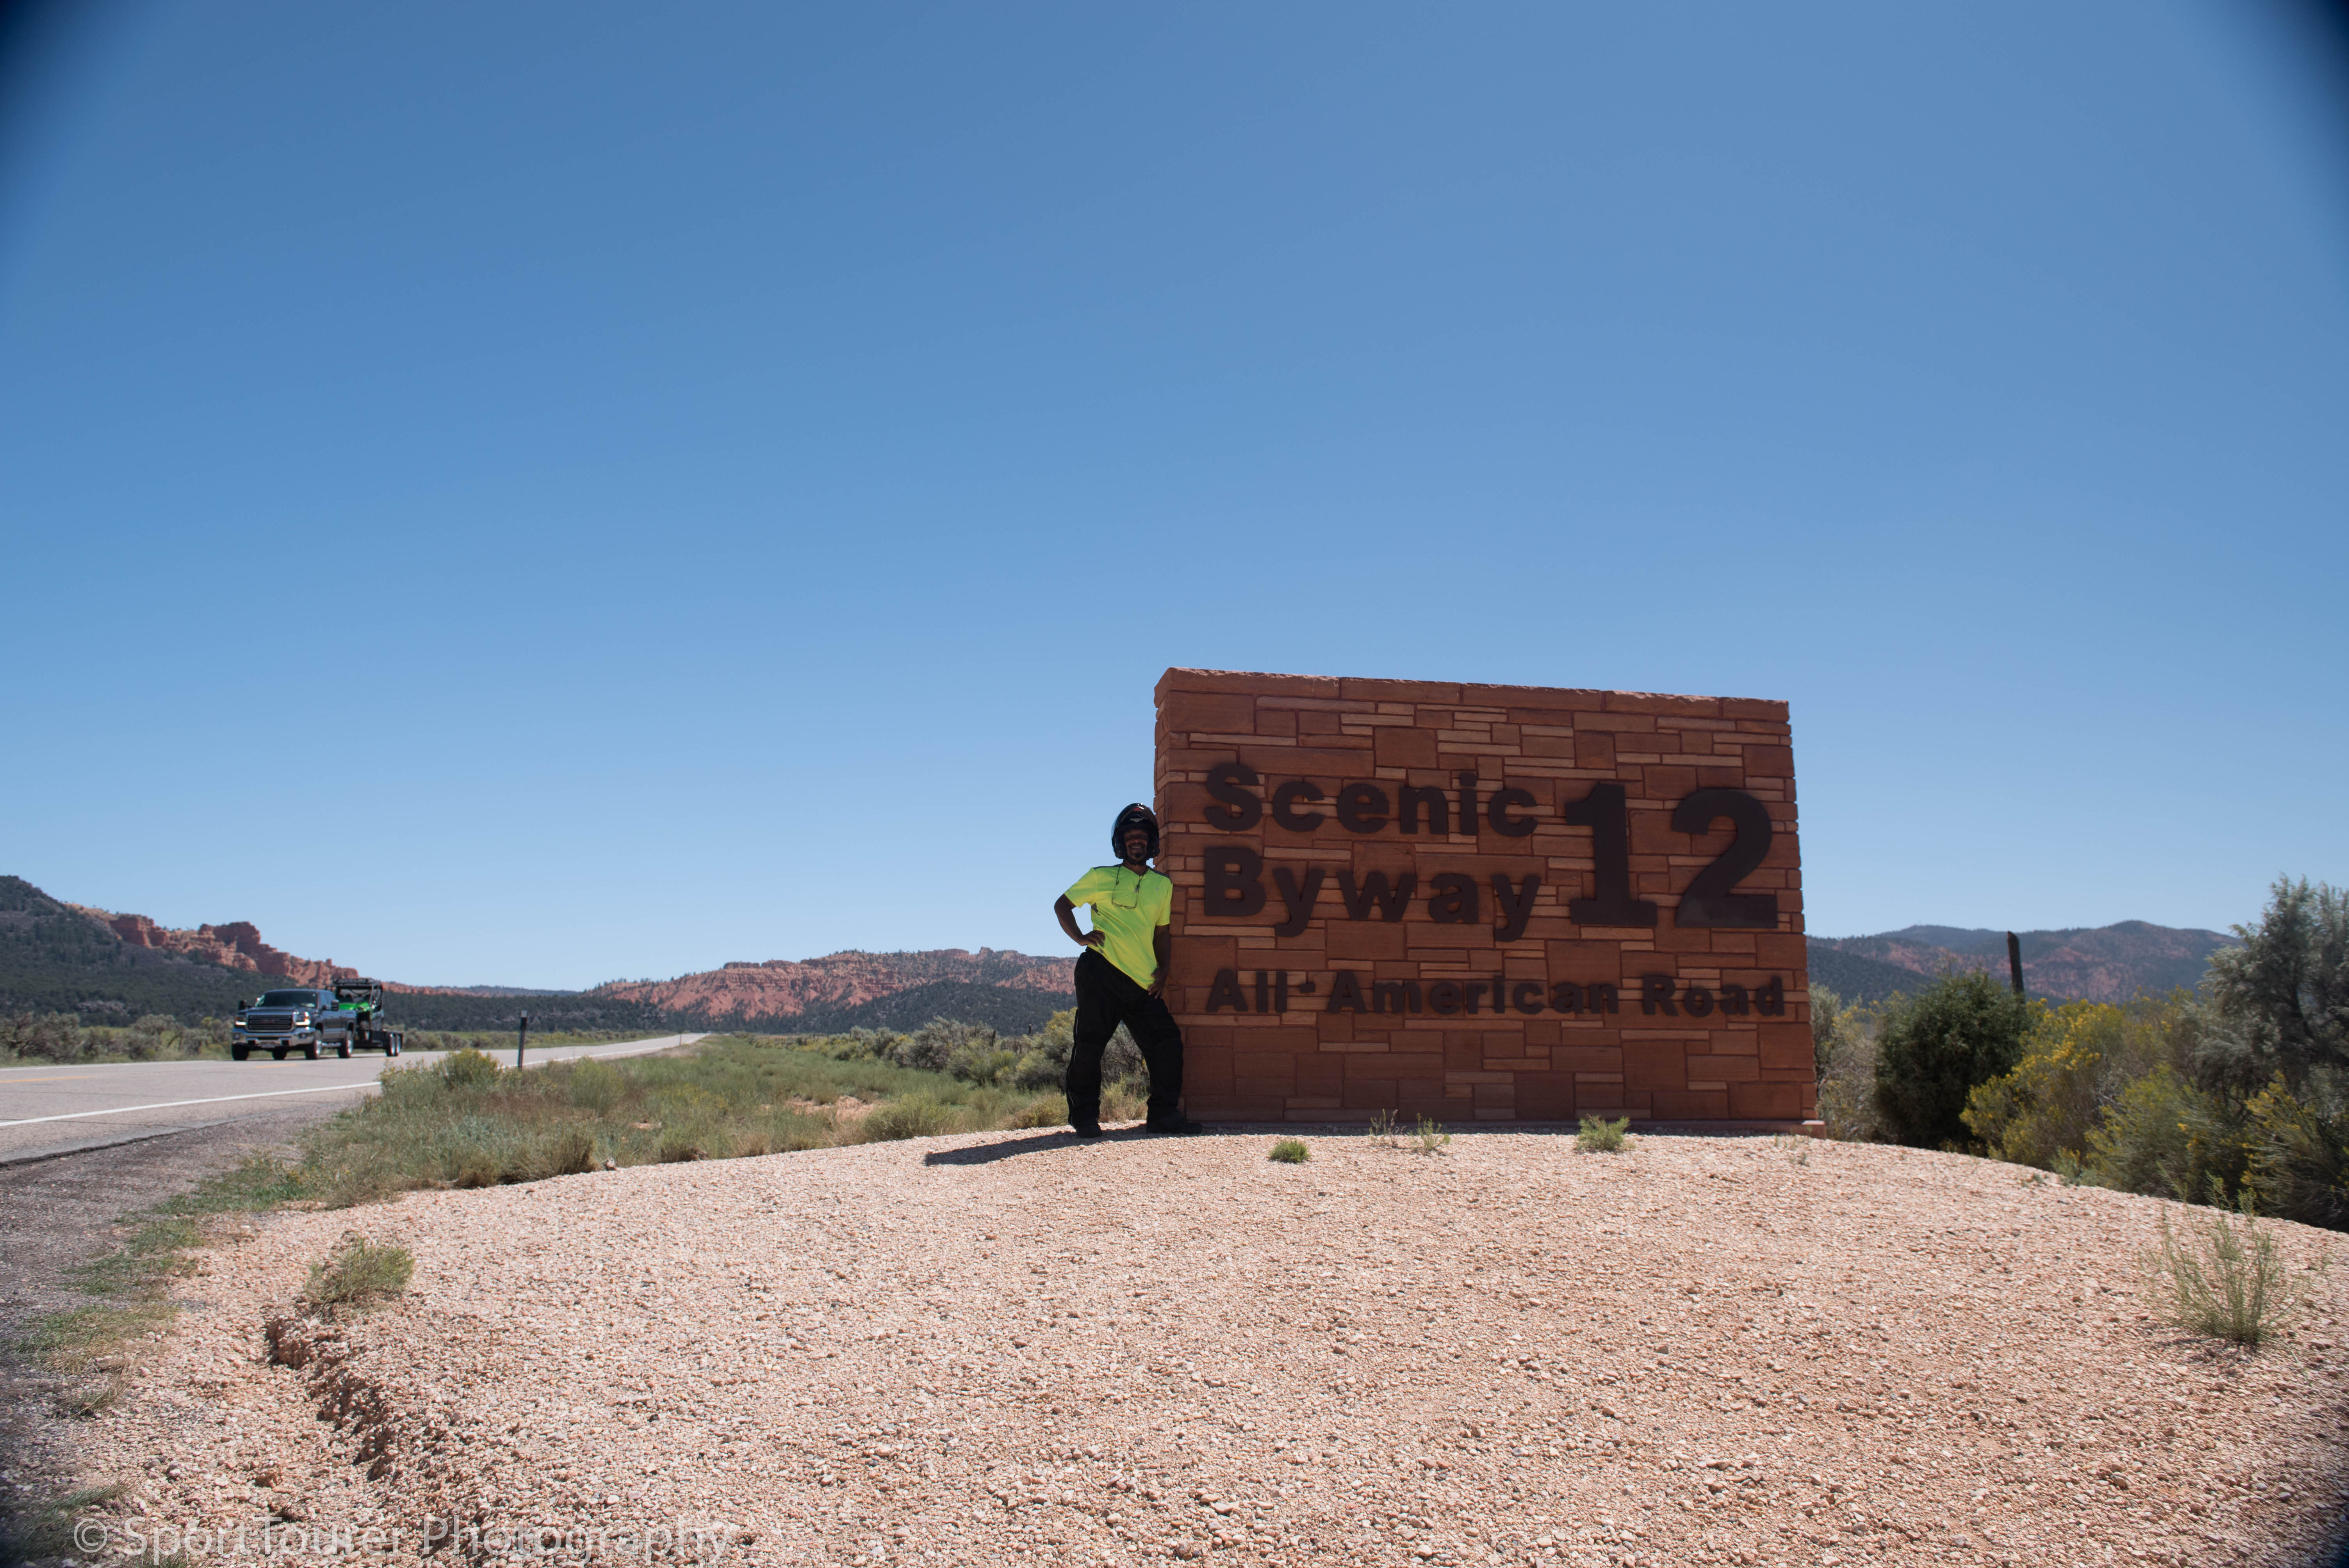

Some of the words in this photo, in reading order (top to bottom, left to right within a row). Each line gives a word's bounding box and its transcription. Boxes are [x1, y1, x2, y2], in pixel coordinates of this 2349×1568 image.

[1204, 764, 1539, 838] Scenic
[1203, 846, 1542, 943] Byway
[1565, 783, 1779, 929] 12
[1642, 975, 1786, 1017] Road
